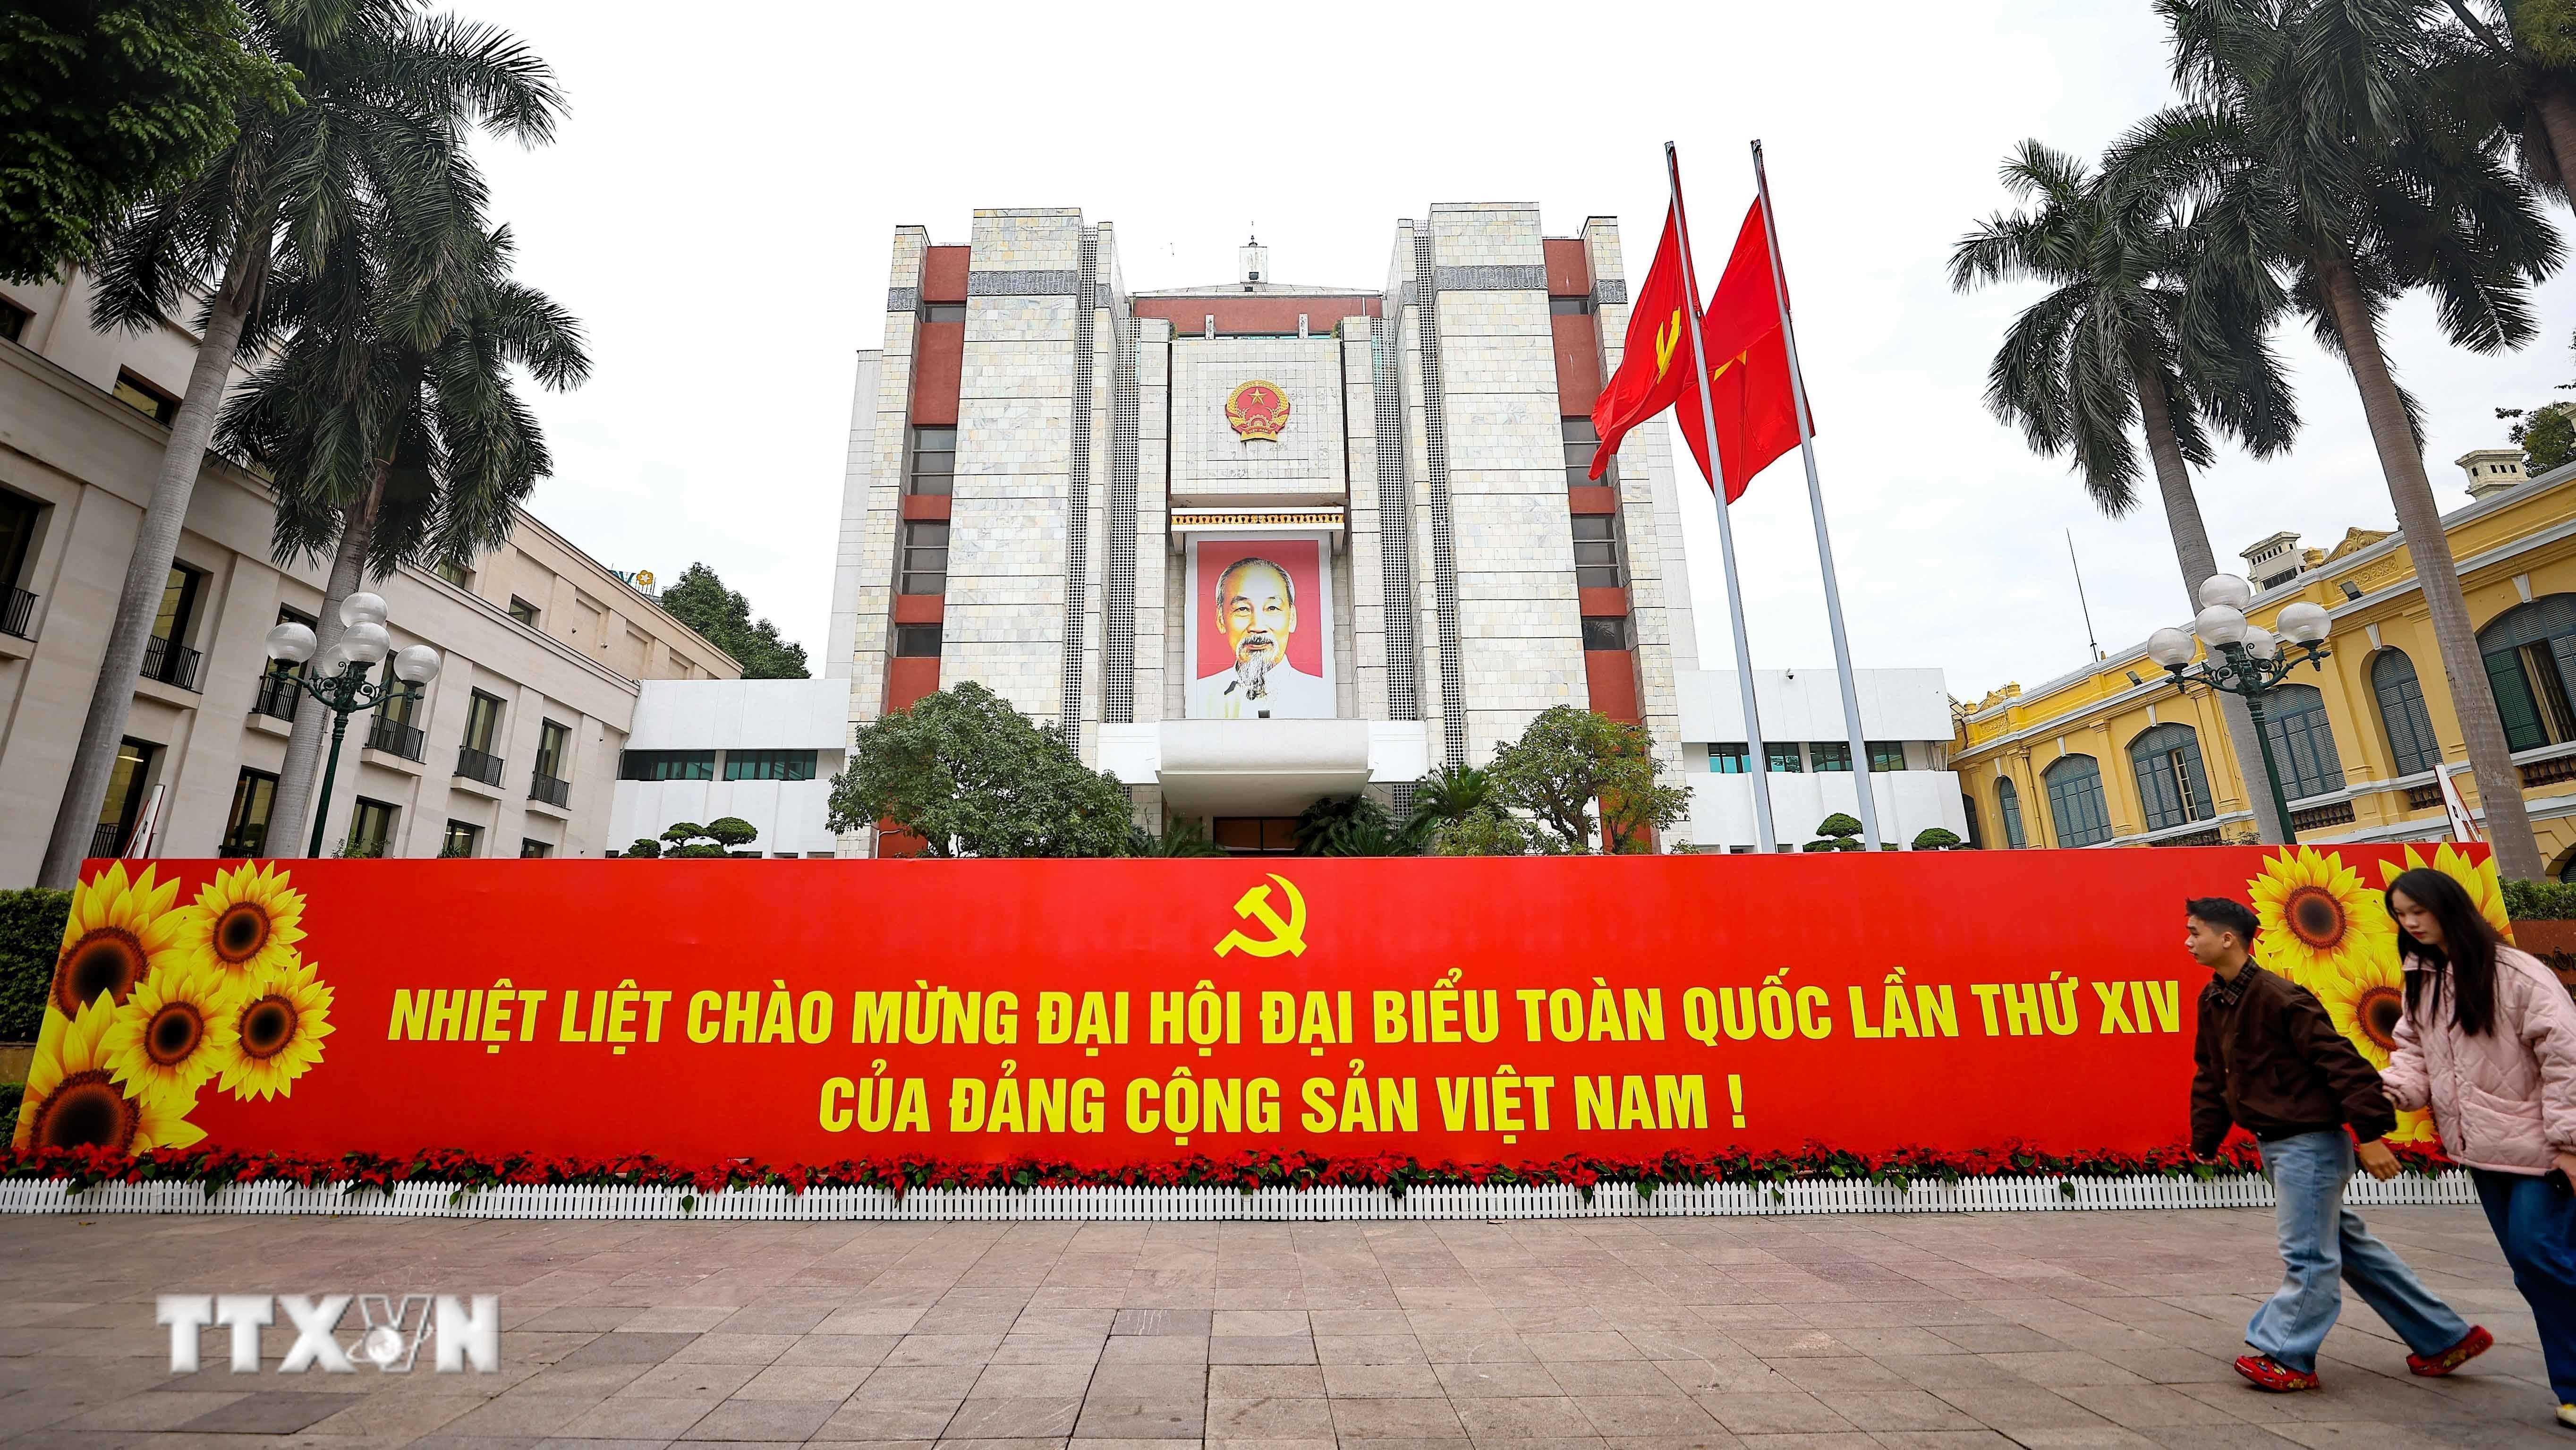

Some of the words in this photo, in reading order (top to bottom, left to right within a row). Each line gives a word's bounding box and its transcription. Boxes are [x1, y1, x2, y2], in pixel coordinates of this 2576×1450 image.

[388, 979, 547, 1054] NHIỆT
[560, 979, 672, 1055] LIỆT
[687, 980, 833, 1044] CHÀO
[852, 980, 1018, 1045] MỪNG
[1037, 991, 1129, 1057] ĐẠI
[1150, 980, 1240, 1057] HỘI
[1259, 991, 1352, 1056] ĐẠI
[1373, 967, 1498, 1043] BIỂU
[1516, 977, 1665, 1042] TOÀN
[1683, 967, 1831, 1047] QUỐC
[1848, 966, 1959, 1038] LẦN
[1971, 971, 2078, 1036] THỨ
[2091, 980, 2179, 1034] XIV
[820, 1051, 930, 1133] CỦA
[949, 1059, 1104, 1134] ĐẢNG
[1126, 1066, 1280, 1146] CỘNG
[1302, 1058, 1418, 1133] SẢN
[1436, 1064, 1554, 1144] VIỆT
[1574, 1075, 1708, 1131] NAM
[1728, 1074, 1746, 1128] !
